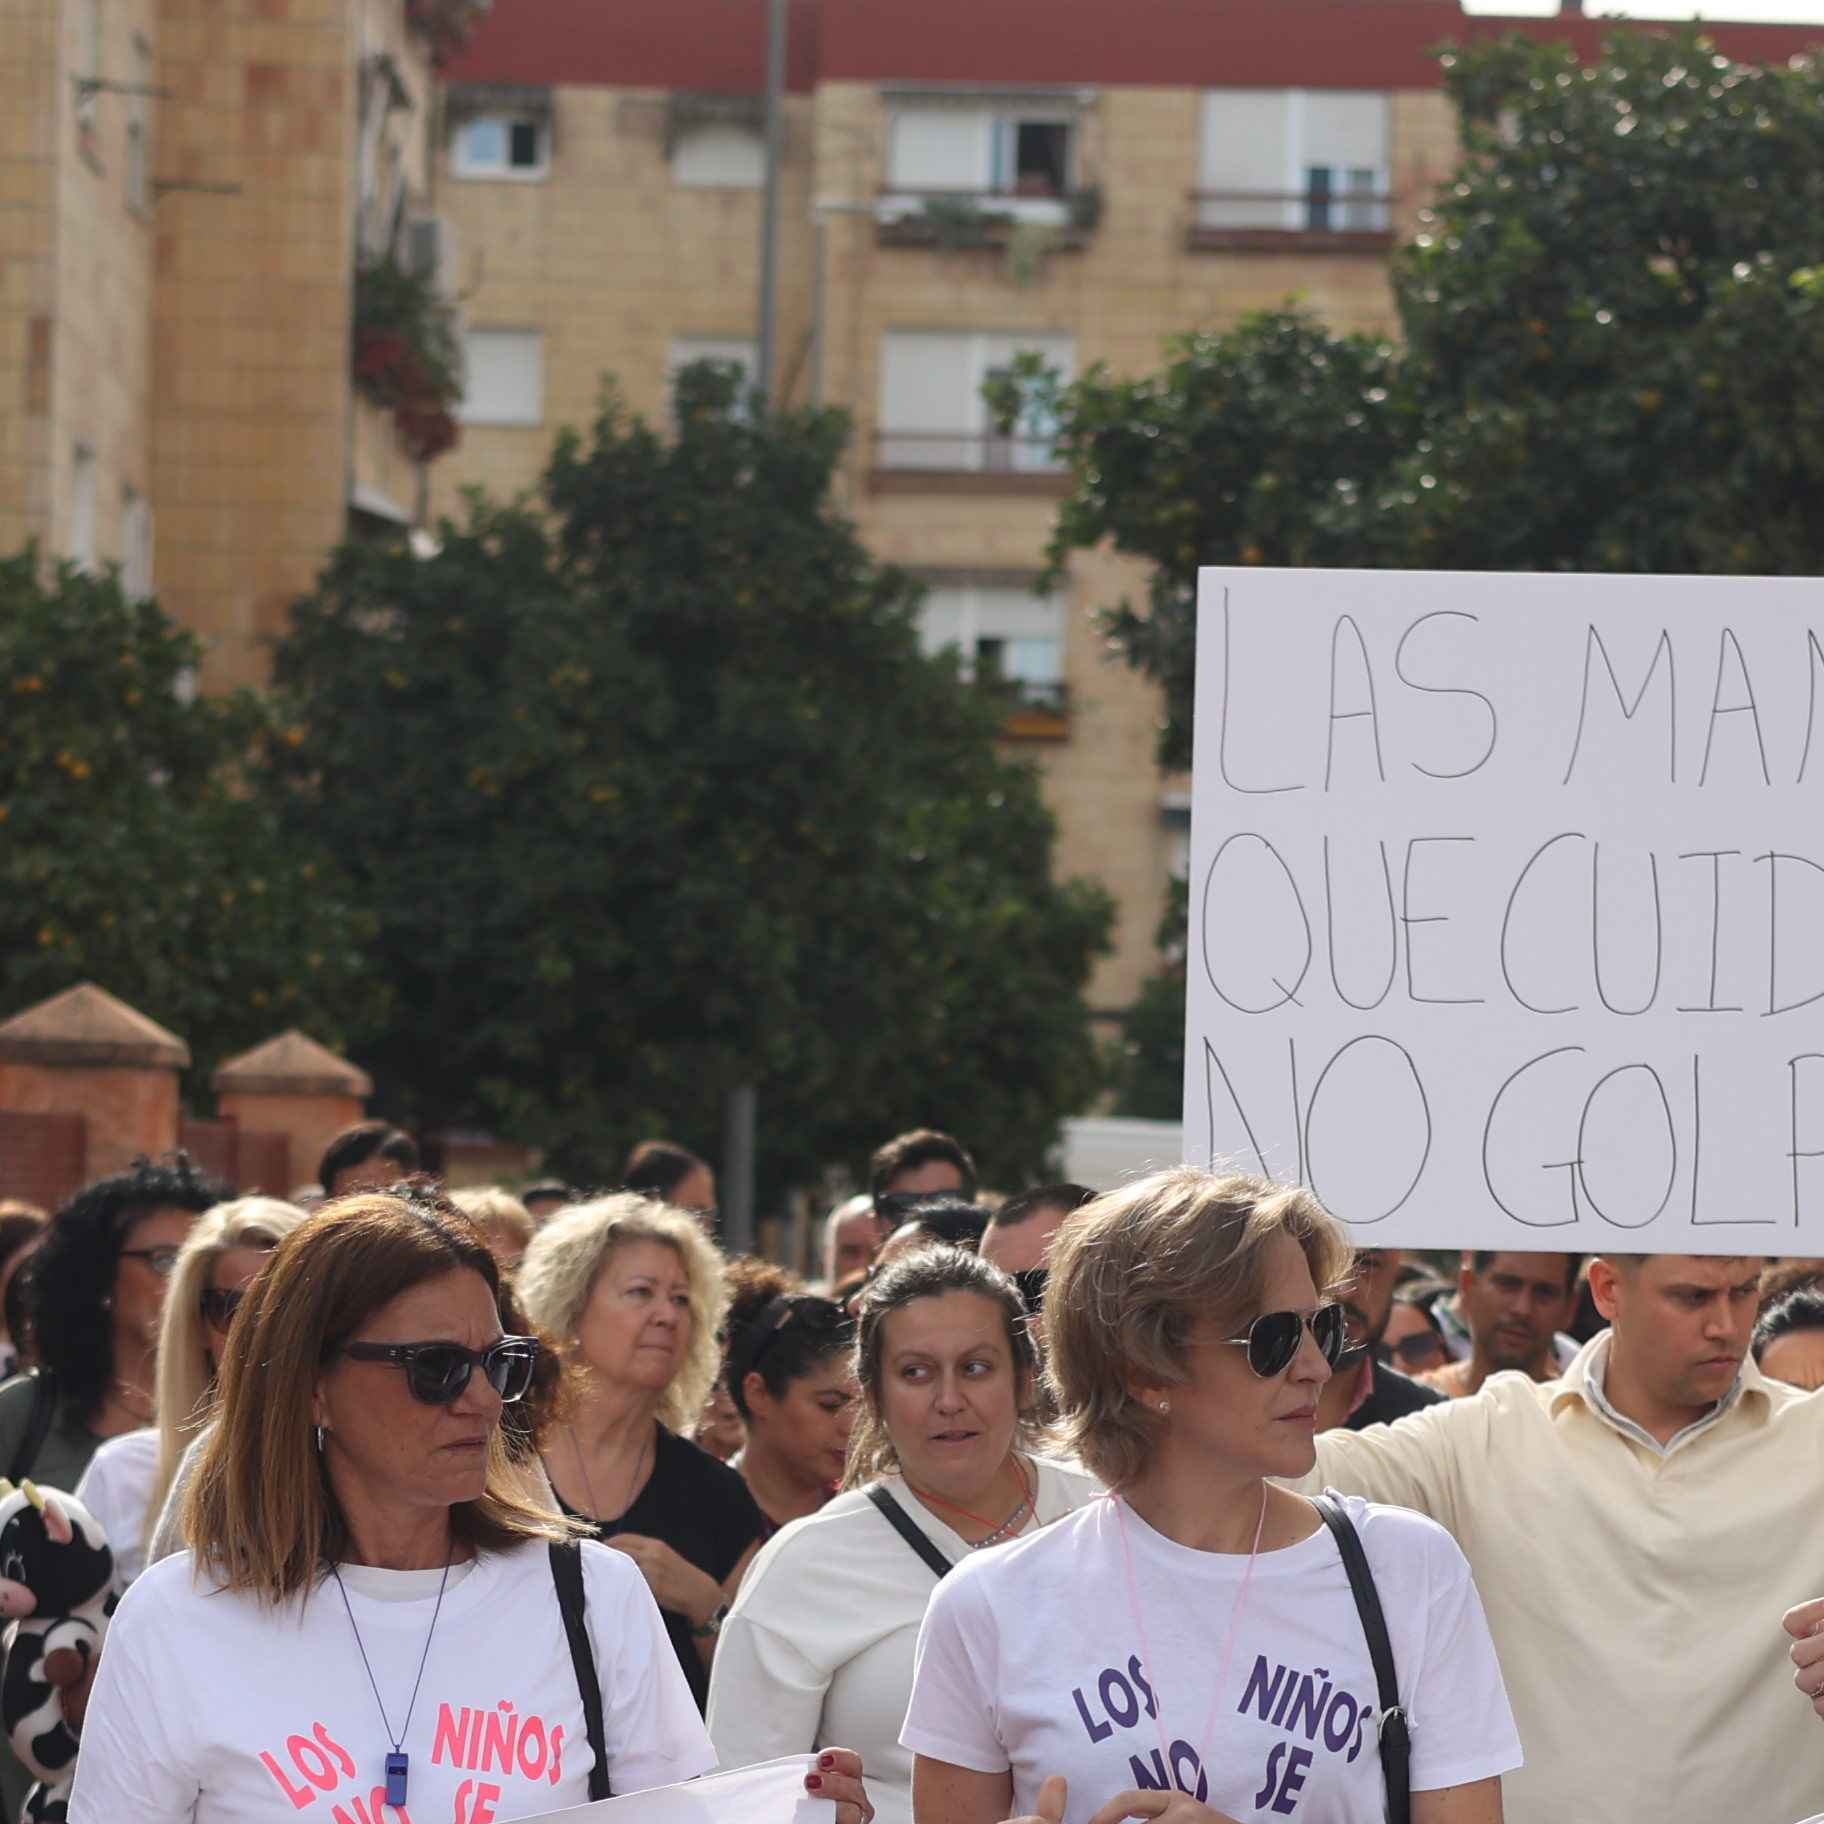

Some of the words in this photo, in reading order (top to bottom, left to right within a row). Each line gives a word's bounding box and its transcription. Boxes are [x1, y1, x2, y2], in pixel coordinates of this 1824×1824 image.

[1220, 586, 1497, 794] LAS
[1202, 832, 1484, 1014] QUE
[1203, 1034, 1431, 1223] NO
[258, 1721, 356, 1809] LOS
[432, 1699, 565, 1786] NIÑOS
[1072, 1655, 1160, 1743] LOS
[1237, 1655, 1373, 1763] NIÑOS
[1129, 1740, 1208, 1803] NO
[1256, 1742, 1314, 1815] SE
